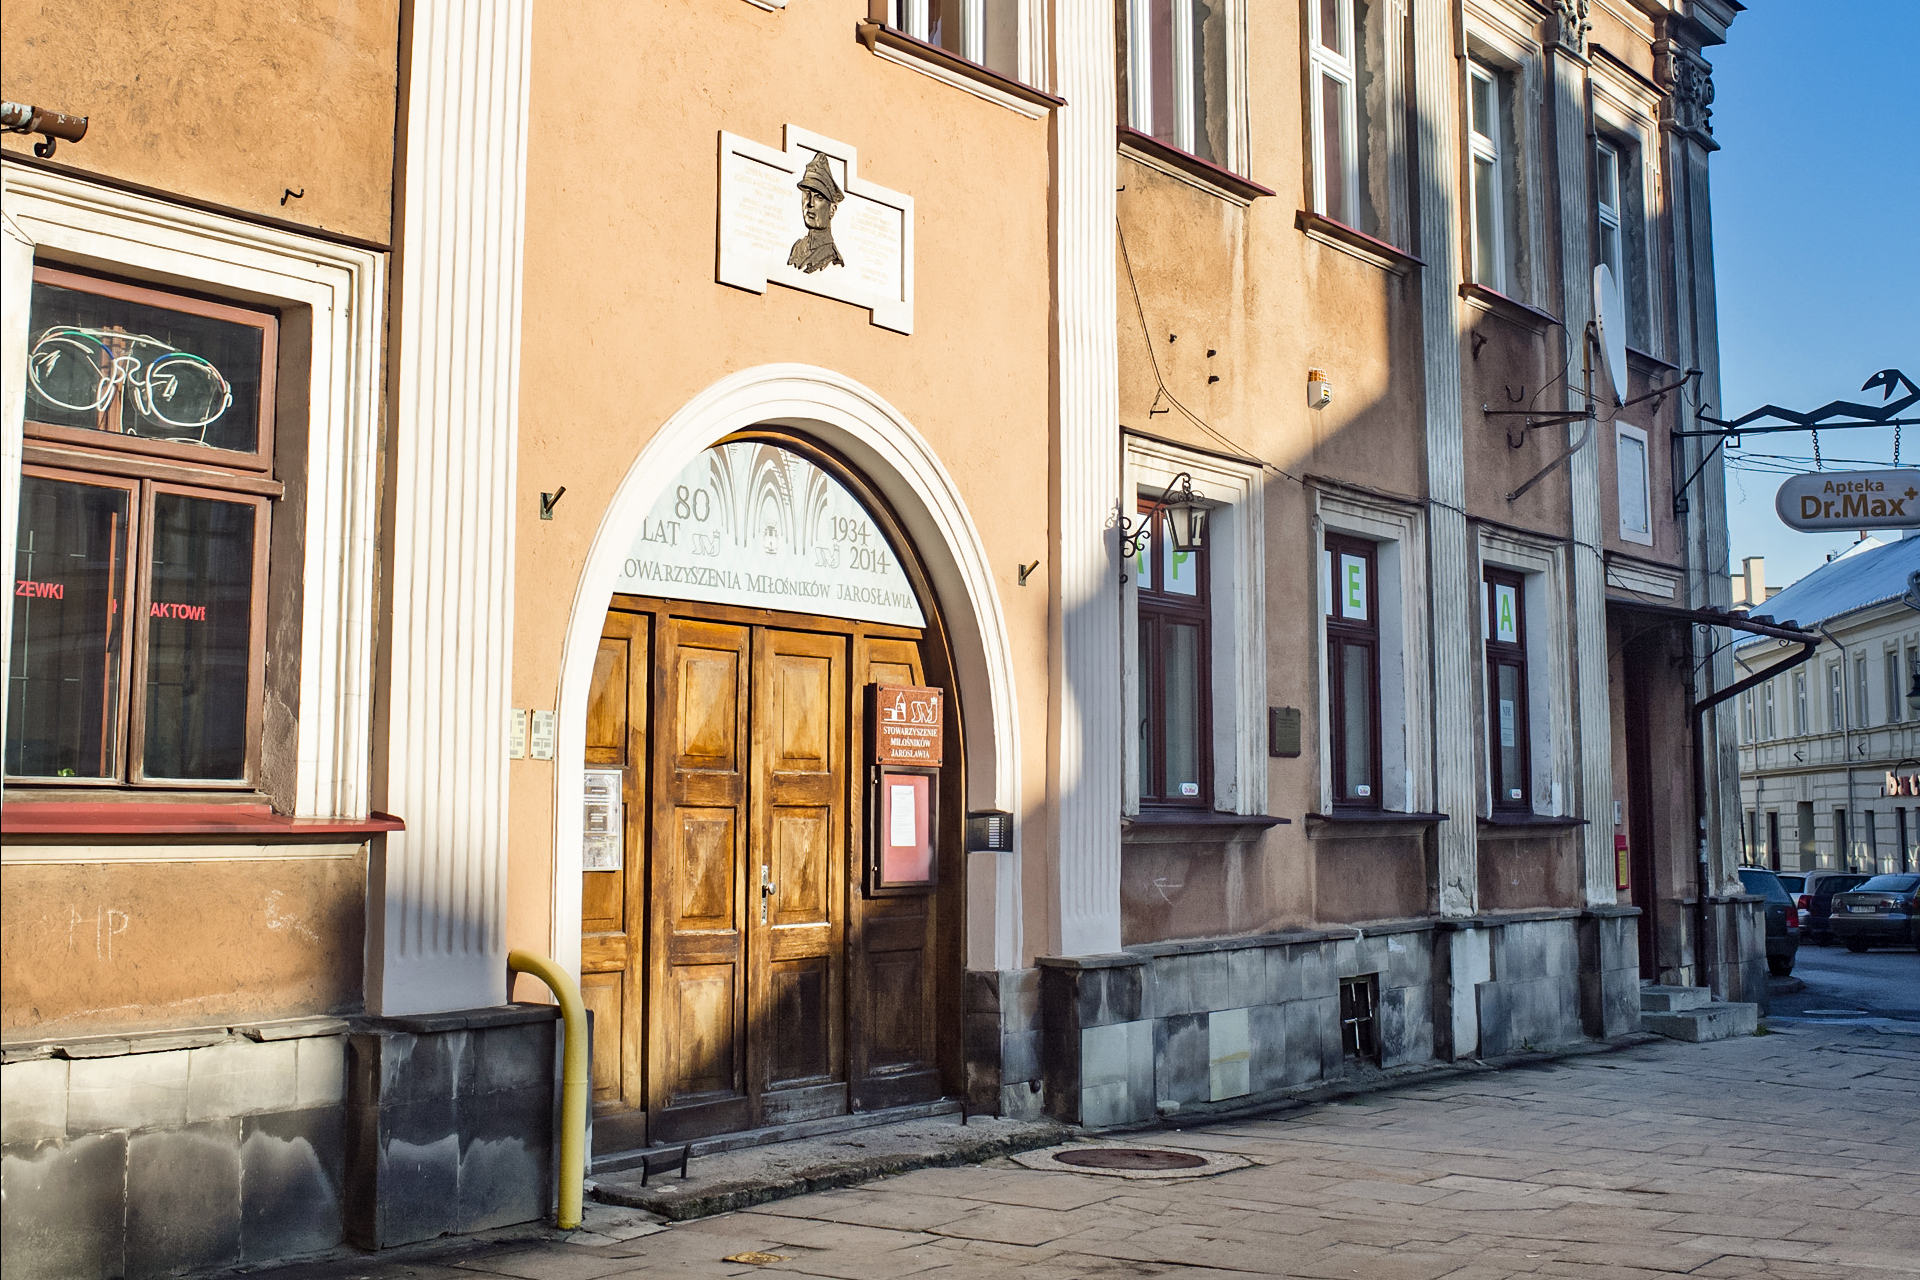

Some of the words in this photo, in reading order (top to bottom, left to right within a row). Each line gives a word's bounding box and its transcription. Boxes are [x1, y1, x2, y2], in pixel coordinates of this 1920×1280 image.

[1823, 479, 1884, 496] Apteka
[675, 484, 710, 522] 80
[1801, 494, 1906, 519] Dr.Max
[641, 516, 681, 547] LAT
[831, 516, 872, 546] 1934
[1192, 515, 1206, 539] 11
[850, 546, 891, 574] 2014
[15, 580, 64, 599] ZEWKI
[619, 558, 742, 590] OWARZYSZENIA
[745, 572, 831, 599] MIŁOŚNIKÓW
[837, 583, 913, 609] JAROSŁAWIA
[1348, 564, 1361, 608] E
[1500, 593, 1513, 633] A
[883, 726, 938, 737] STOWARZYSZENIE
